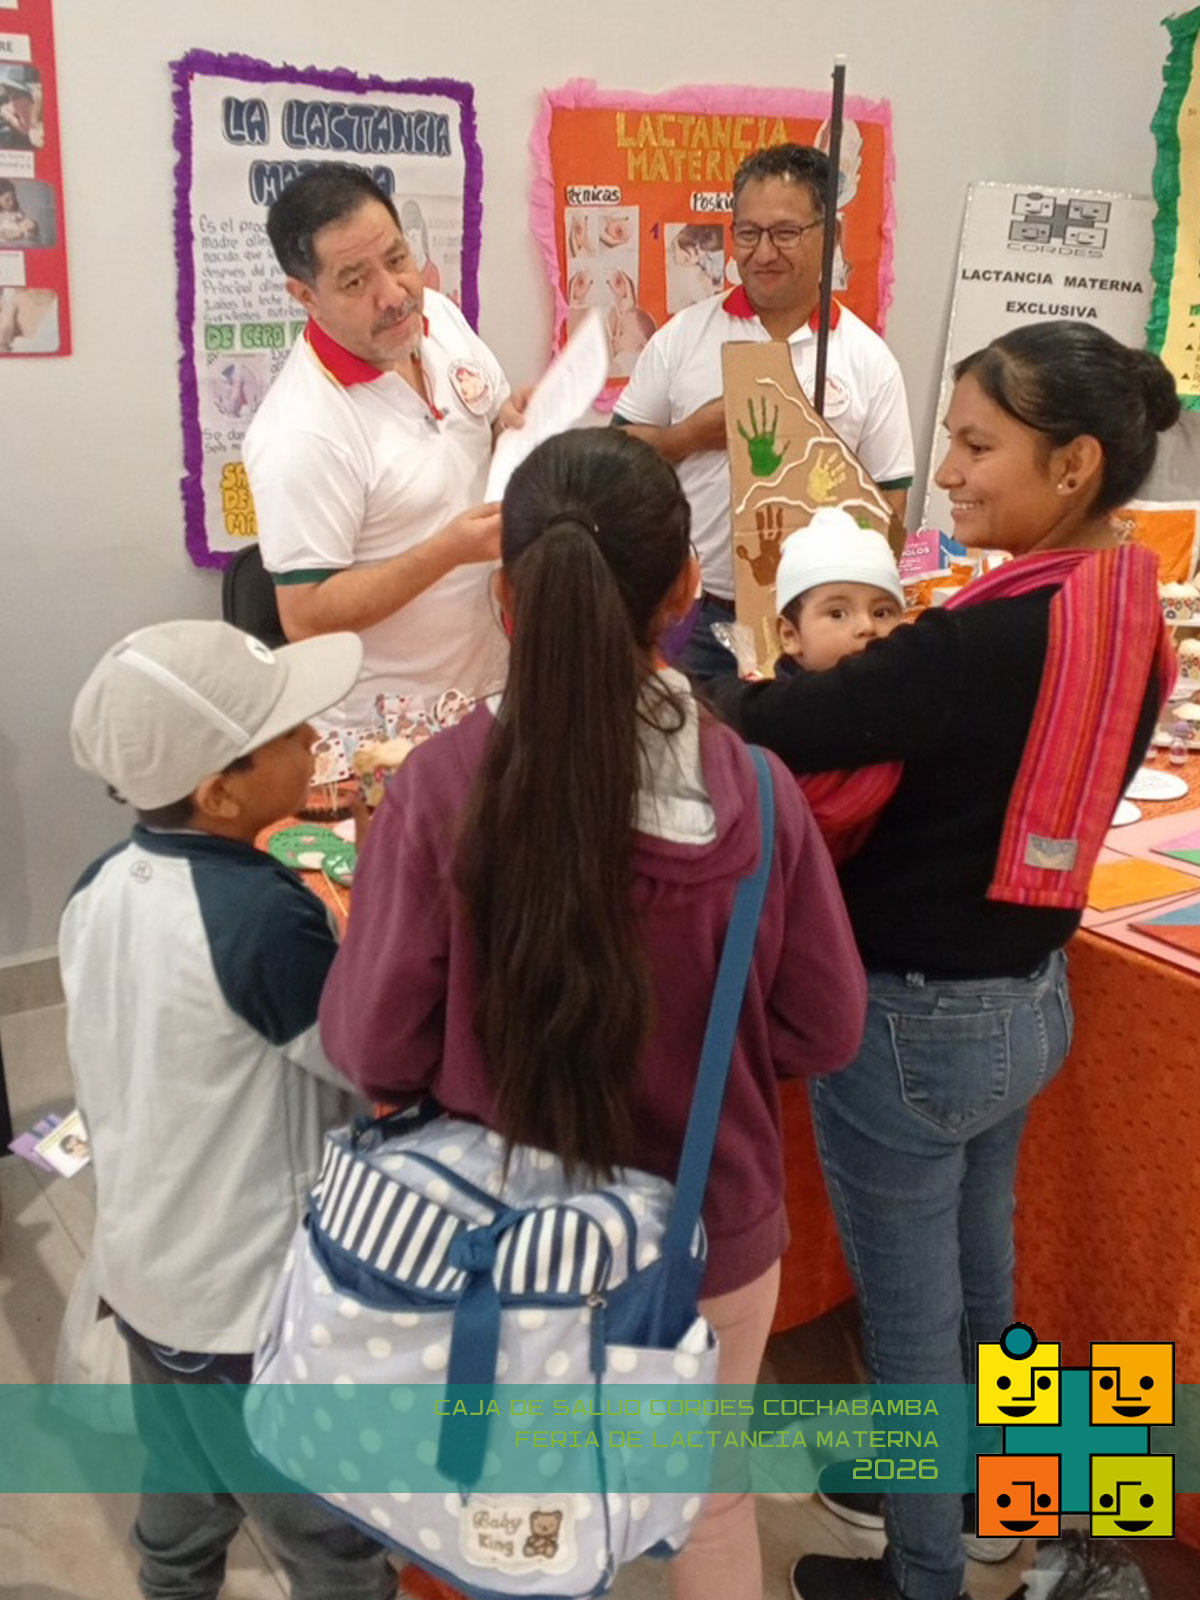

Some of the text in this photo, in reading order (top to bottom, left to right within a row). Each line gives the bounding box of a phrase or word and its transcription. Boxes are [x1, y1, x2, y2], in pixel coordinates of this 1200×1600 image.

[222, 96, 270, 146] LA
[616, 112, 789, 149] LACTANCIA
[627, 149, 745, 182] MATERN
[220, 217, 233, 233] el
[1006, 242, 1104, 259] CORDES
[961, 268, 1144, 294] LACTANCIA MATERNA
[1005, 301, 1099, 320] EXCLUSIVA
[205, 323, 236, 350] DE
[473, 1511, 522, 1536] Baby
[478, 1533, 515, 1557] King
